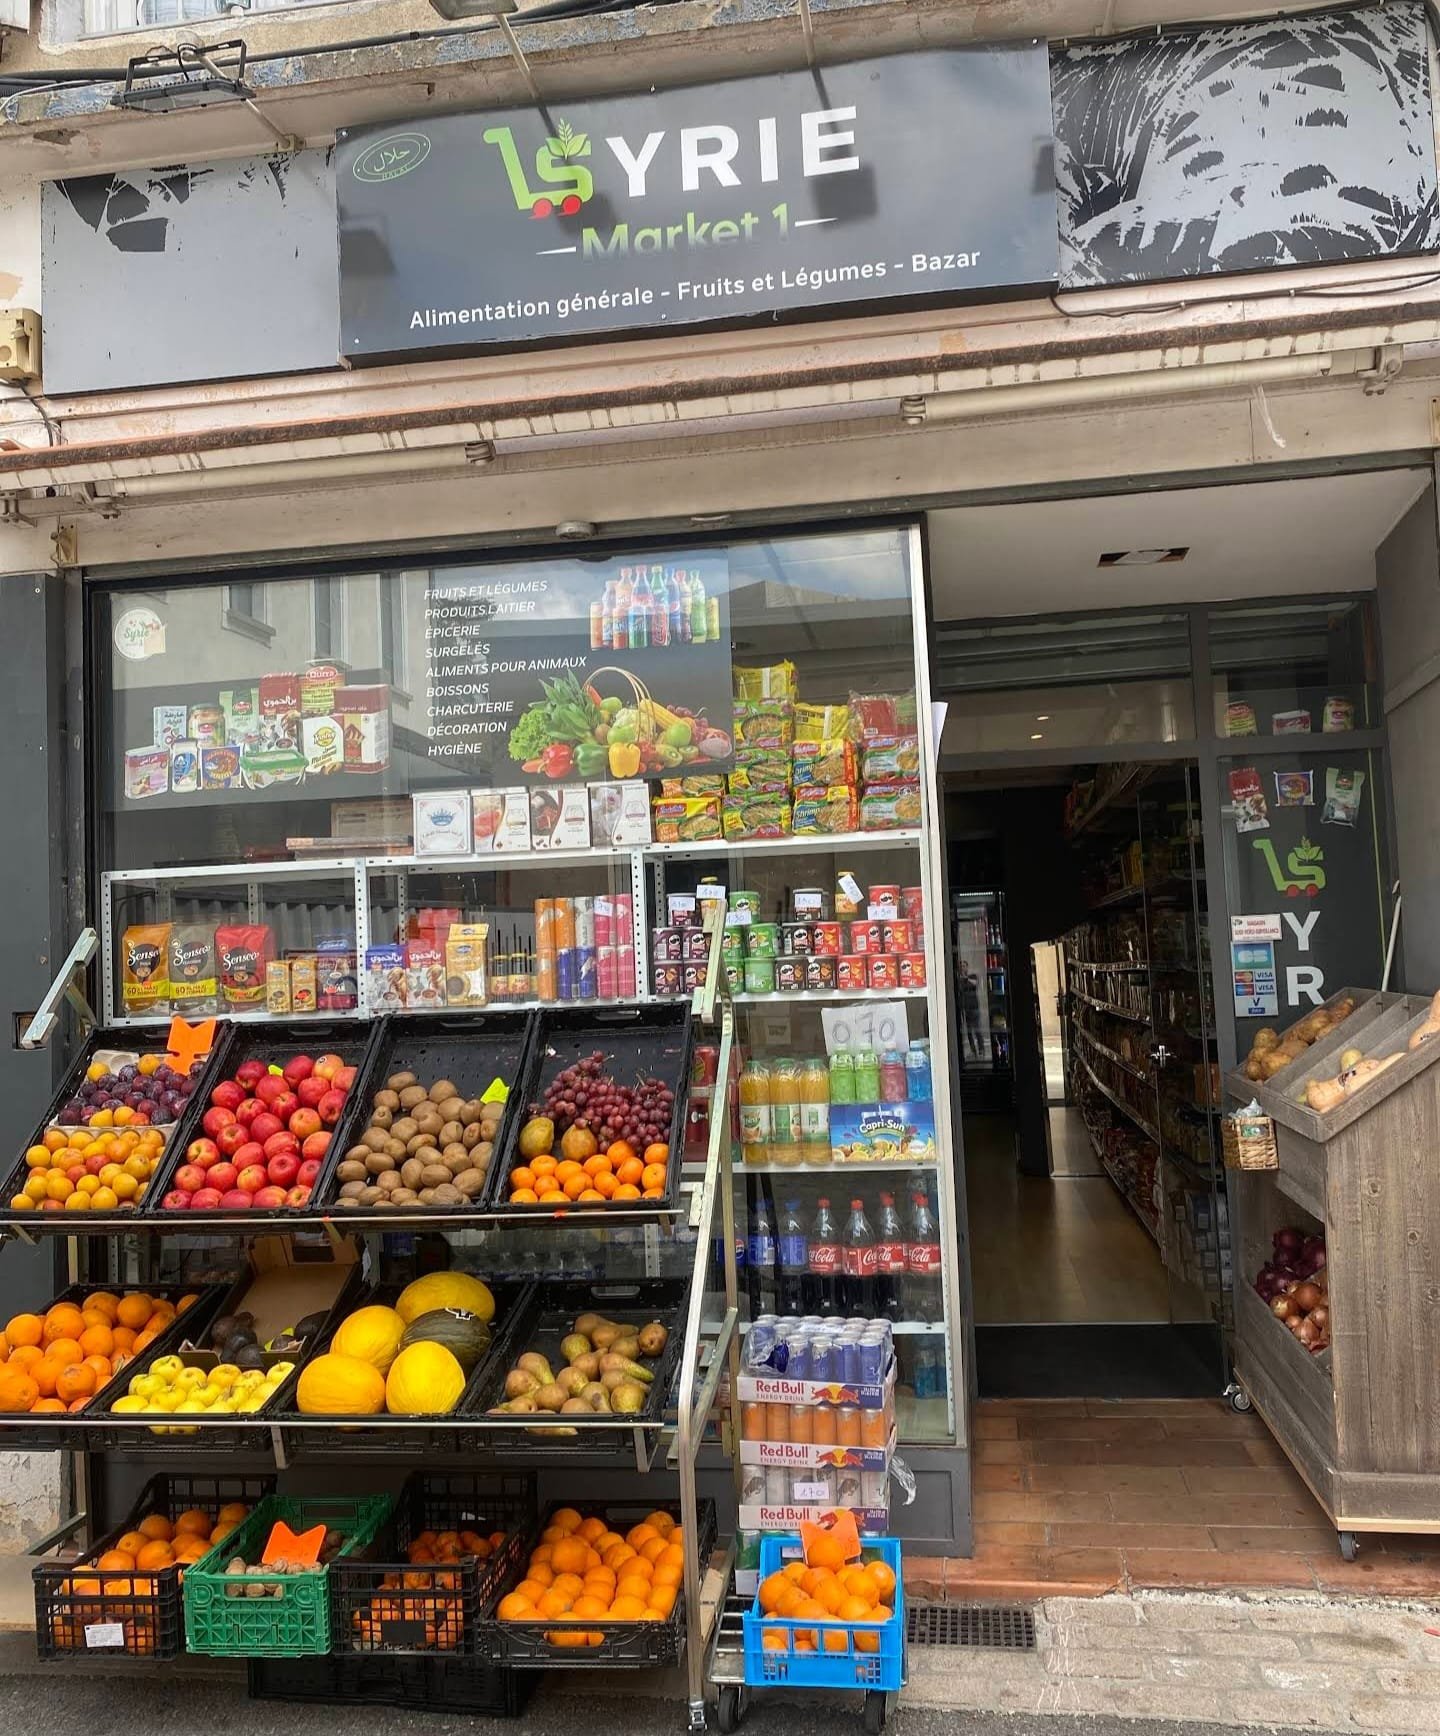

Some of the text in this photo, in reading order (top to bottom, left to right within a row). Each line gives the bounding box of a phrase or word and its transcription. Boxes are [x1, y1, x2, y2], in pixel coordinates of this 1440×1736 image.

[374, 147, 410, 172] حلال
[583, 203, 790, 258] Market 1
[410, 298, 550, 329] Alimentation
[557, 287, 653, 318] générale
[678, 277, 745, 300] Fruits
[751, 273, 775, 292] et
[781, 261, 887, 290] Légumes
[912, 251, 981, 273] Bazar
[424, 579, 548, 600] FRUITS ET LÉGUMES
[424, 601, 536, 619] PRODUITS LAITIER
[424, 624, 480, 639] ÉPICERIE
[425, 643, 490, 659] SURGELÉS
[426, 655, 587, 678] ALIMENTS POUR ANIMAUX
[426, 682, 489, 698] BOISSONS
[427, 701, 514, 718] CHARCUTERIE
[427, 721, 507, 737] DÉCORATION
[428, 741, 482, 757] HYGIÈNE
[756, 1380, 805, 1394] Red Bull
[760, 1444, 809, 1458] Red Bull
[760, 1508, 810, 1521] Red Bull
